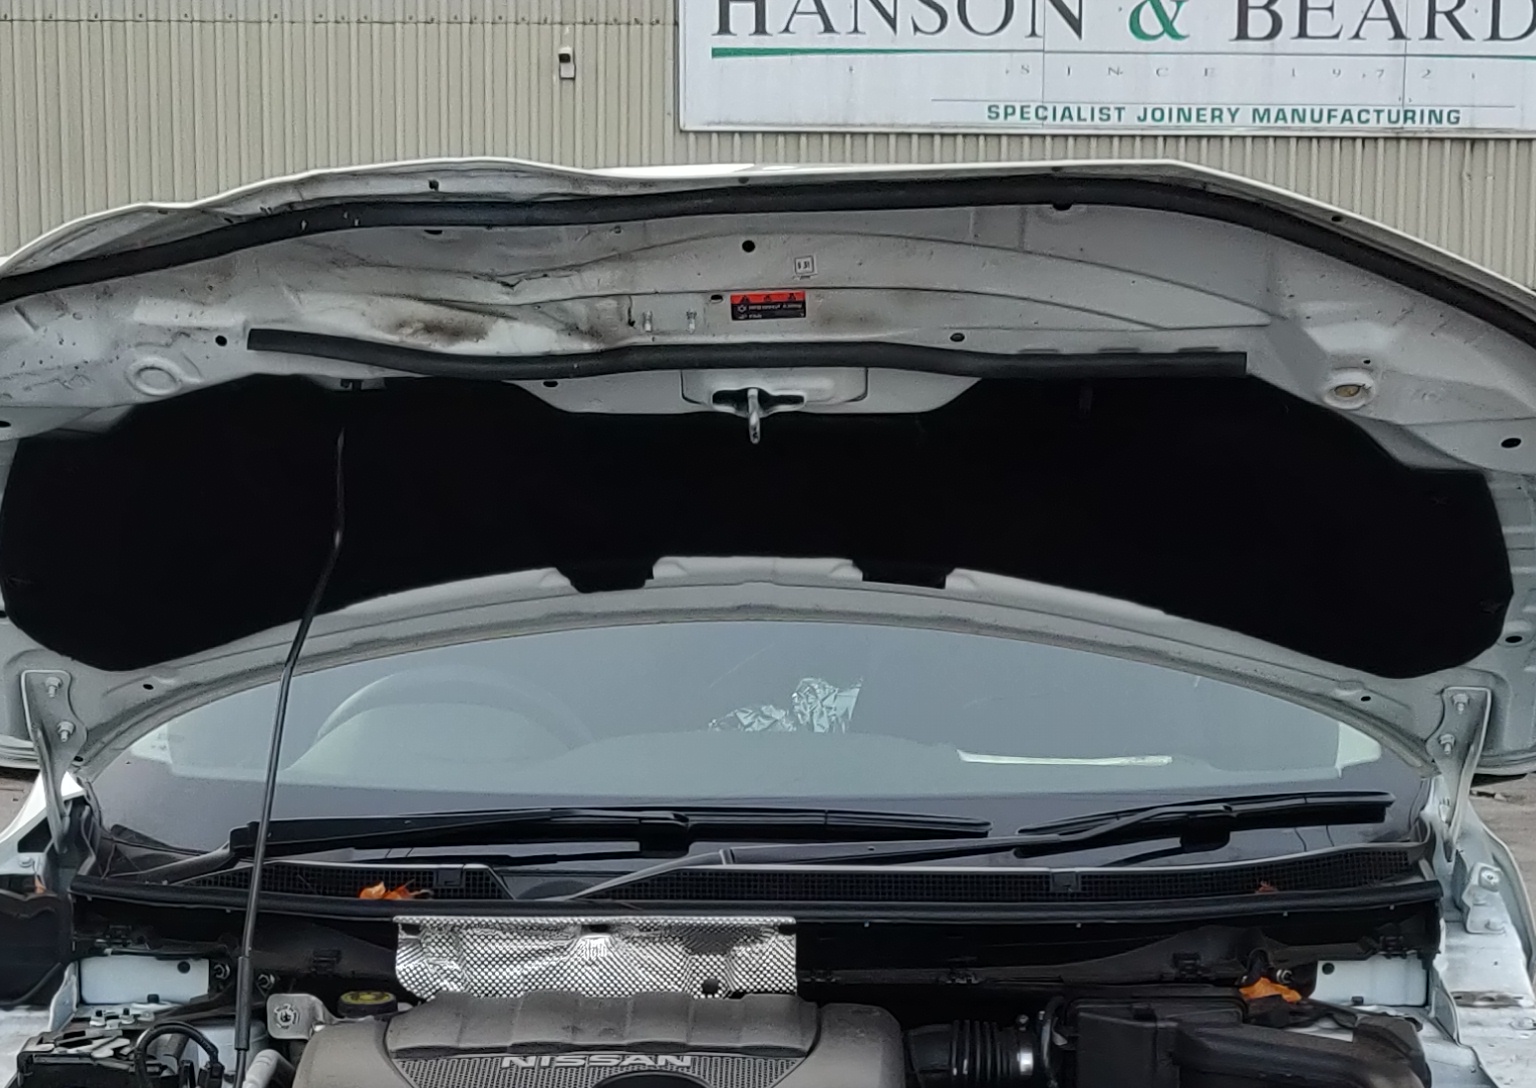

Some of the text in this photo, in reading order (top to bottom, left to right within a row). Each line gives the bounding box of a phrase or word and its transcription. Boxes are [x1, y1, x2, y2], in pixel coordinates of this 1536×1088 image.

[710, 0, 1083, 40] HANSON
[1128, 0, 1191, 41] &
[986, 103, 1462, 126] SPECIALIST JOINERY MANUFACTURING
[501, 1054, 692, 1068] NISSAN
